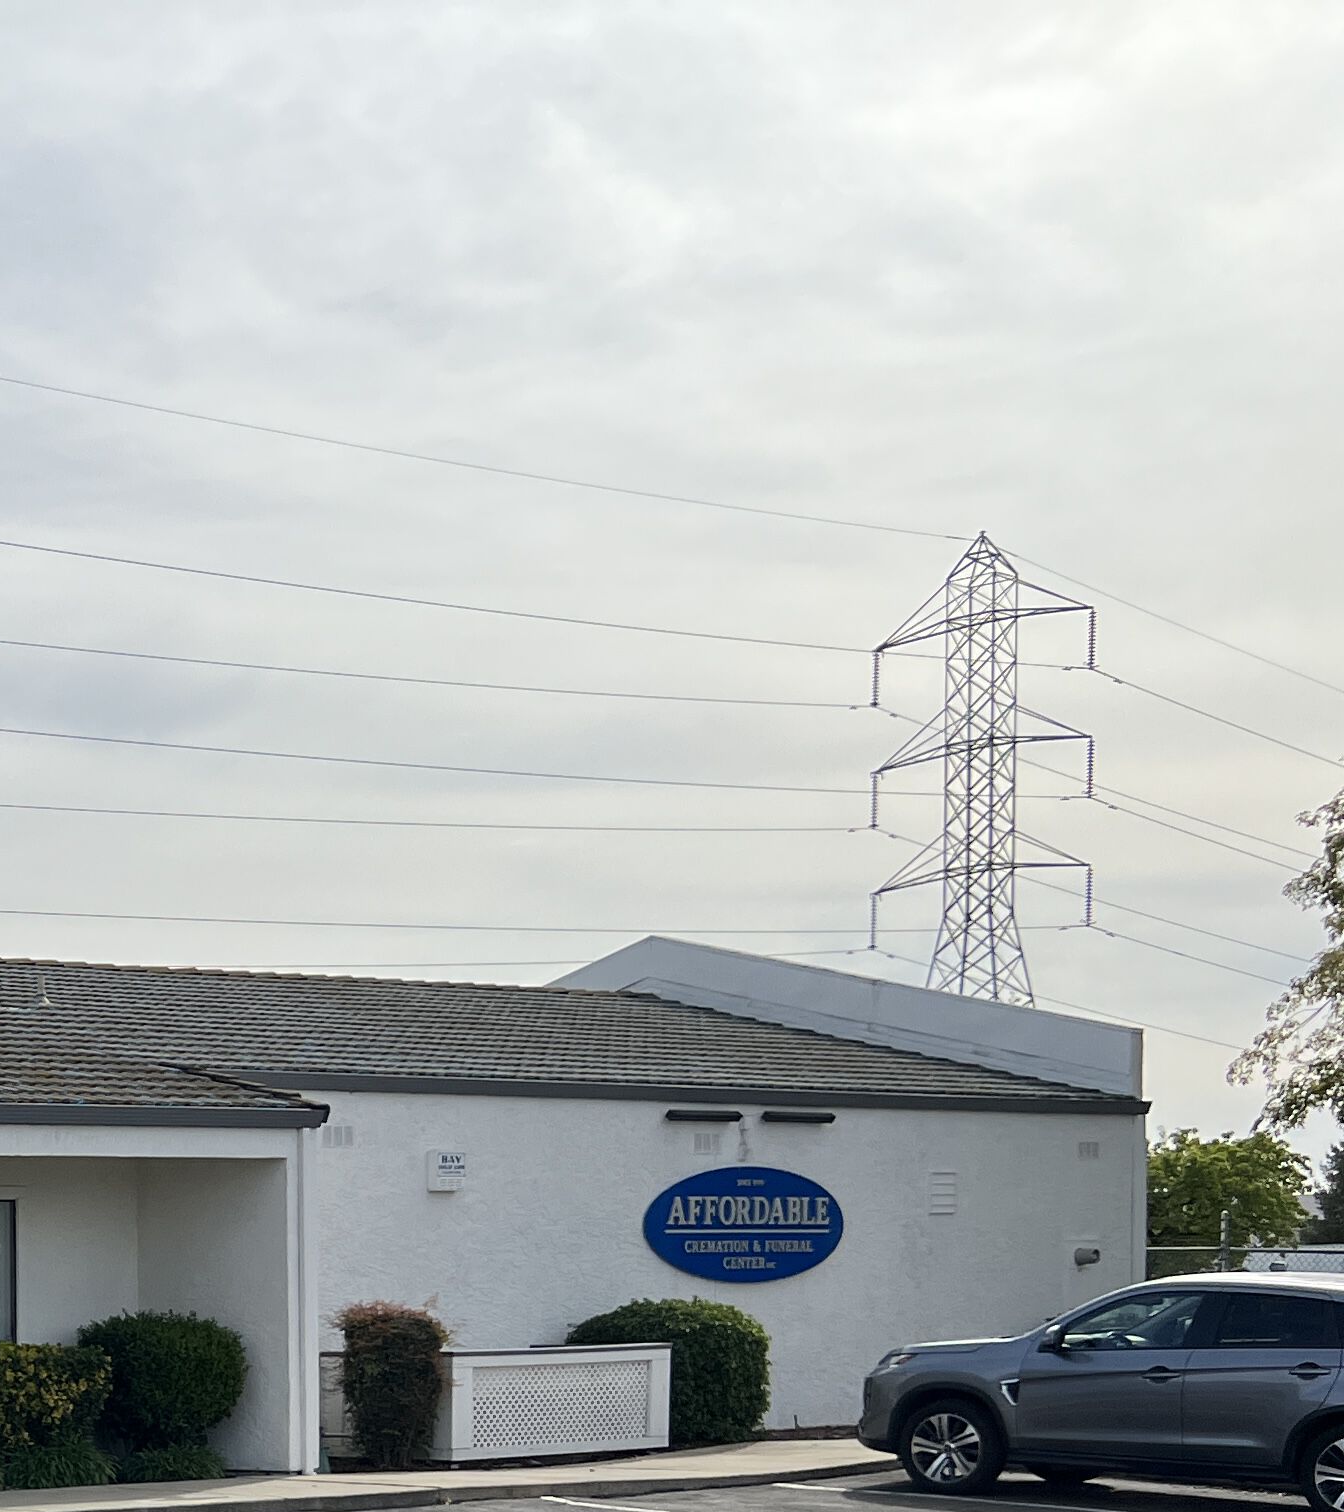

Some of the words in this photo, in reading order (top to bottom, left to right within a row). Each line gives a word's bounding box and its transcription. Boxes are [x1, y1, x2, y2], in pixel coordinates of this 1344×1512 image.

[441, 1155, 462, 1164] BAY
[666, 1196, 830, 1225] AFFORDABLE
[684, 1240, 749, 1253] CREMATION
[752, 1240, 761, 1253] &
[764, 1240, 814, 1253] FUNERAL
[722, 1256, 766, 1269] CENTER
